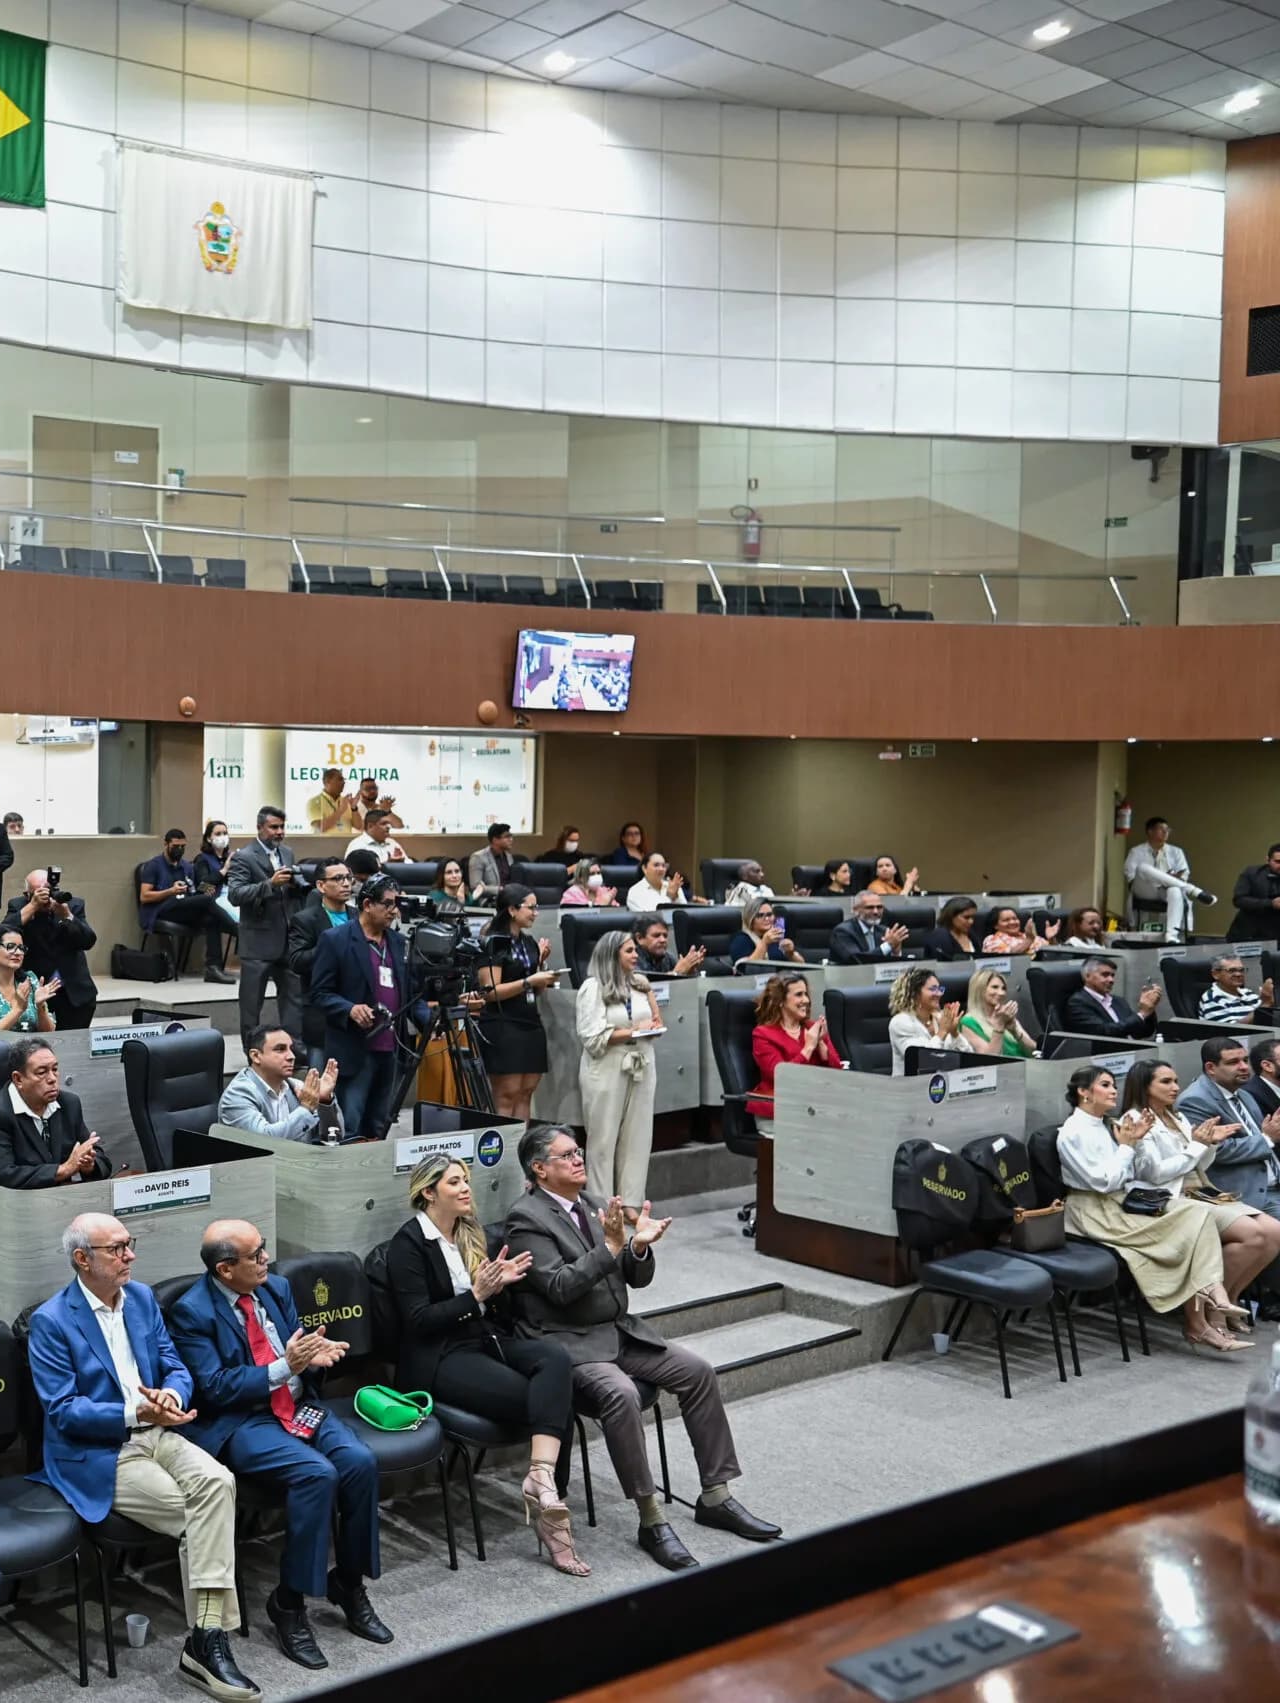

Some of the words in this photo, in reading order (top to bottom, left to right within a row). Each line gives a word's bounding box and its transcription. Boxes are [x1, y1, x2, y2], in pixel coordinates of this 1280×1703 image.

[290, 767, 400, 781] LEGATURA
[102, 1032, 131, 1041] WALLACE
[132, 1031, 159, 1039] OLIVEIRA
[418, 1143, 438, 1153] RAIFF
[439, 1141, 462, 1150] MATOS
[145, 1182, 170, 1192] DAVID
[171, 1179, 190, 1188] REIS
[922, 1177, 966, 1201] RESERVADO
